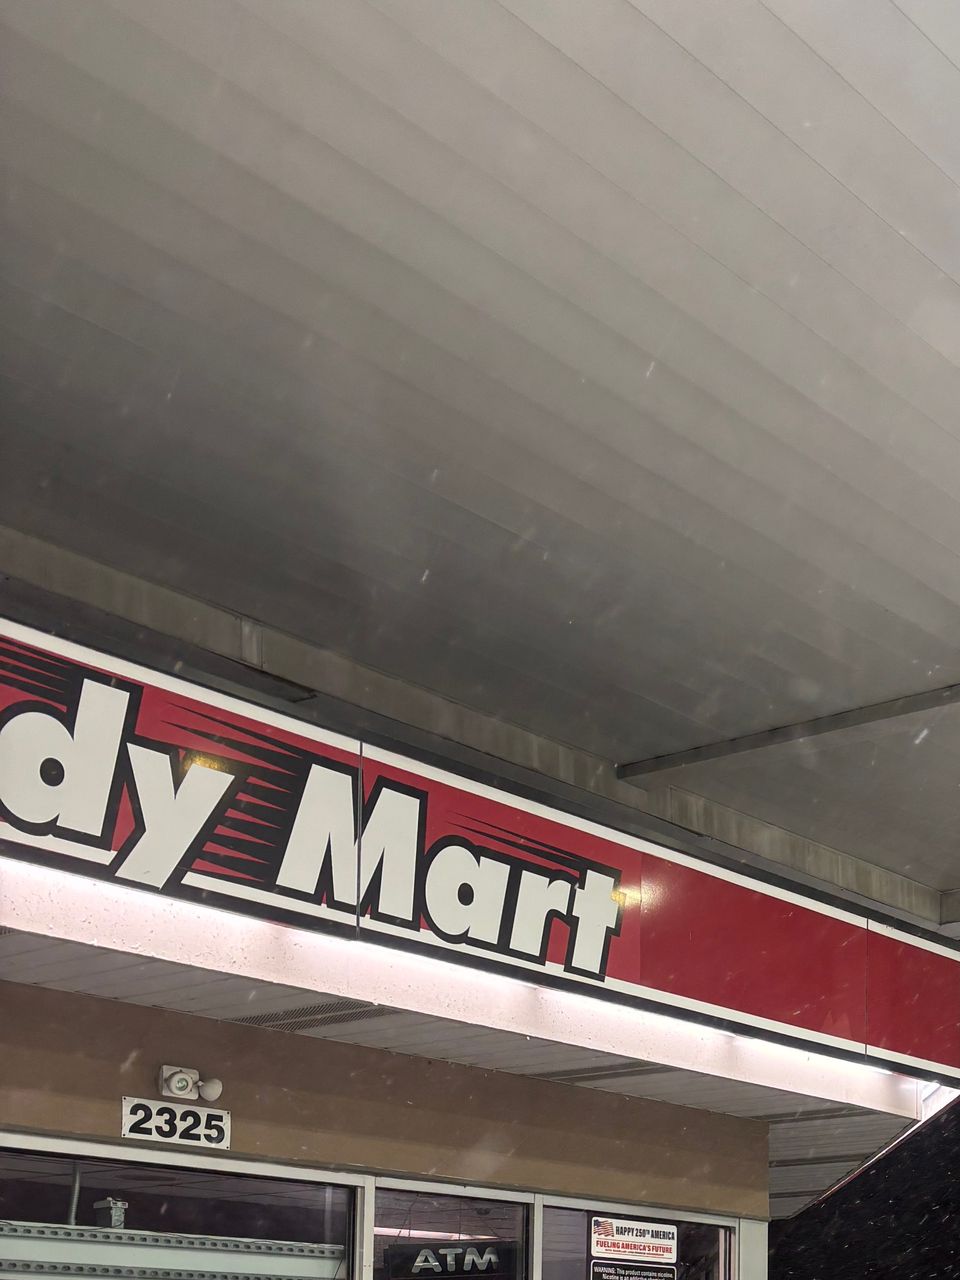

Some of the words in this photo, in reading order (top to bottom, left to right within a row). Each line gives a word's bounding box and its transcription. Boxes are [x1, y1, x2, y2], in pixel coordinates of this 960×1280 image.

[275, 763, 618, 975] Mart
[129, 1103, 225, 1144] 2325
[616, 1226, 634, 1236] HAPPY
[651, 1229, 675, 1240] AMERICA
[596, 1240, 620, 1249] FUELING
[621, 1242, 652, 1252] AMERICA'S
[652, 1245, 673, 1254] FUTURE
[411, 1247, 499, 1273] ATM
[602, 1273, 619, 1280] Nicotine
